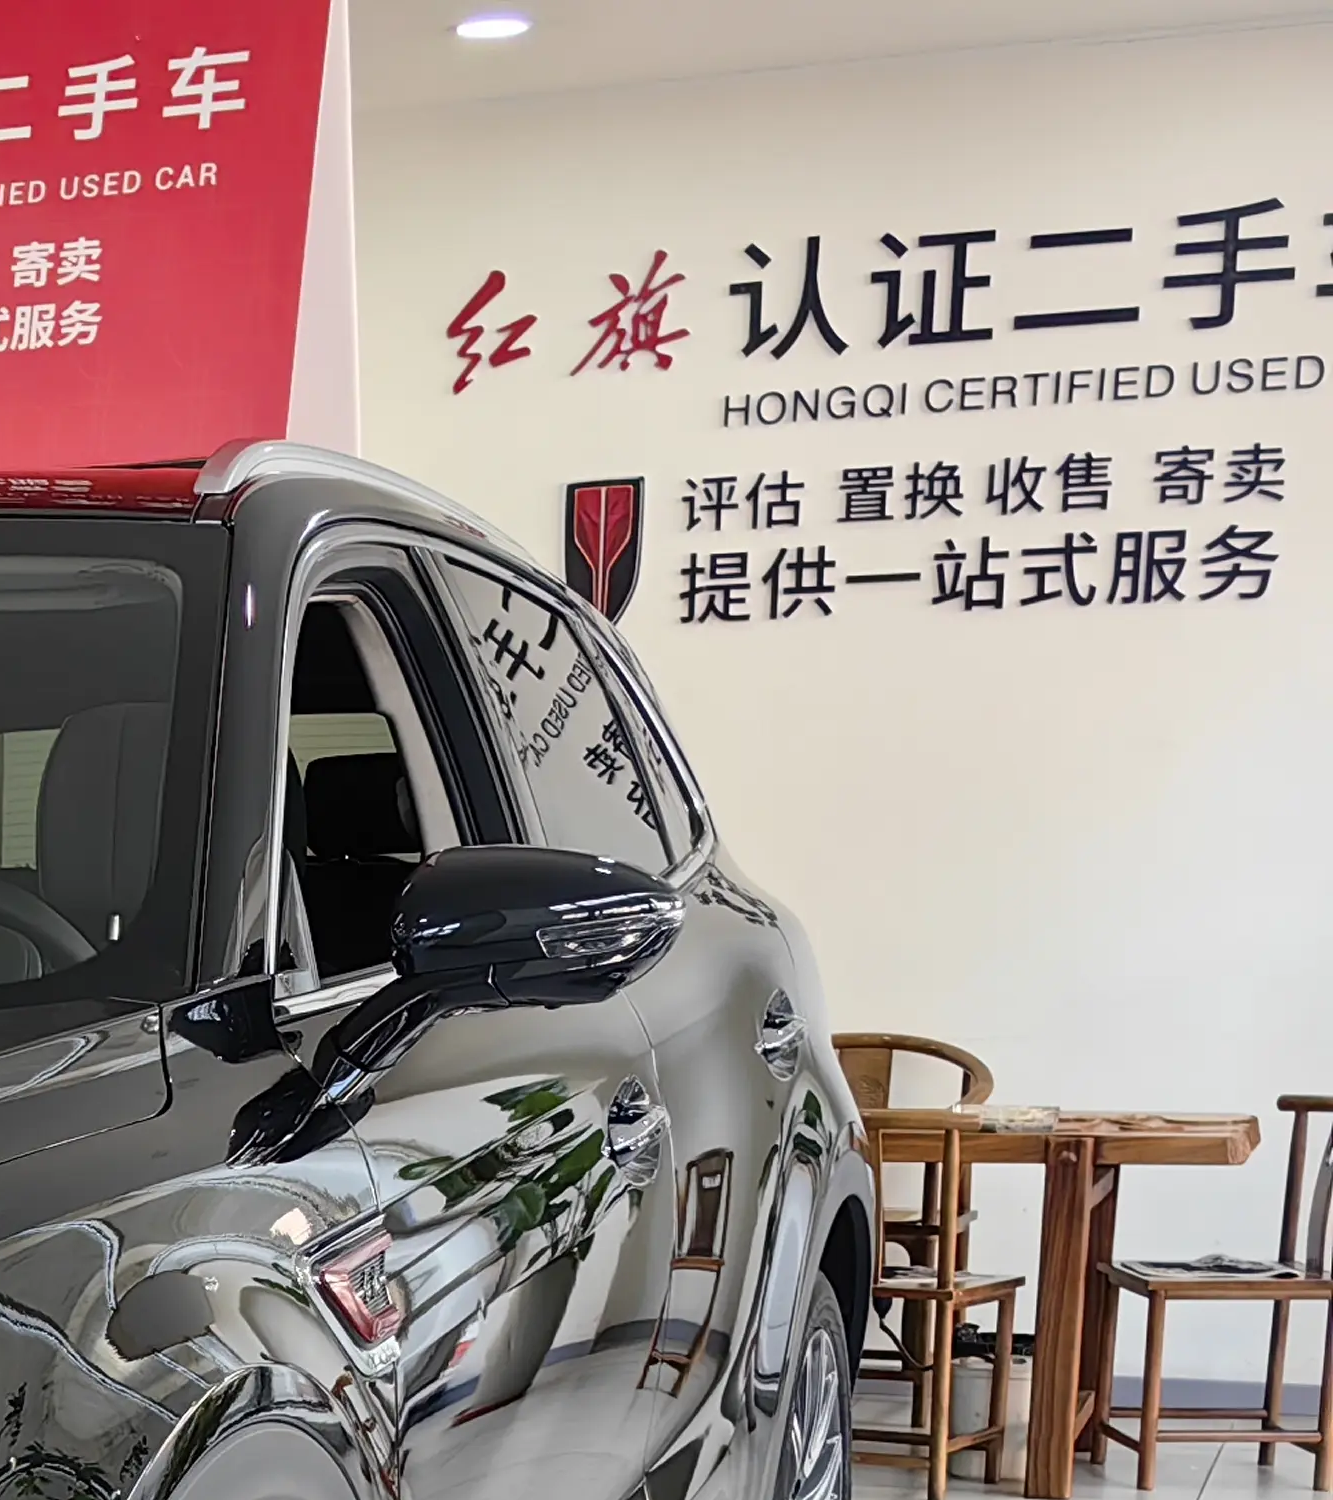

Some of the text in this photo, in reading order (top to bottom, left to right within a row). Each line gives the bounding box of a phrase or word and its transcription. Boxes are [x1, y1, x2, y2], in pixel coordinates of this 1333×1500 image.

[60, 171, 141, 199] USED
[156, 163, 217, 190] CAR
[11, 237, 102, 287] 寄卖
[724, 356, 1324, 427] HONGQI CERTIFIED USED
[682, 443, 1285, 531] 评估 置换 收售 寄卖
[680, 525, 1278, 623] 提供一站式服务
